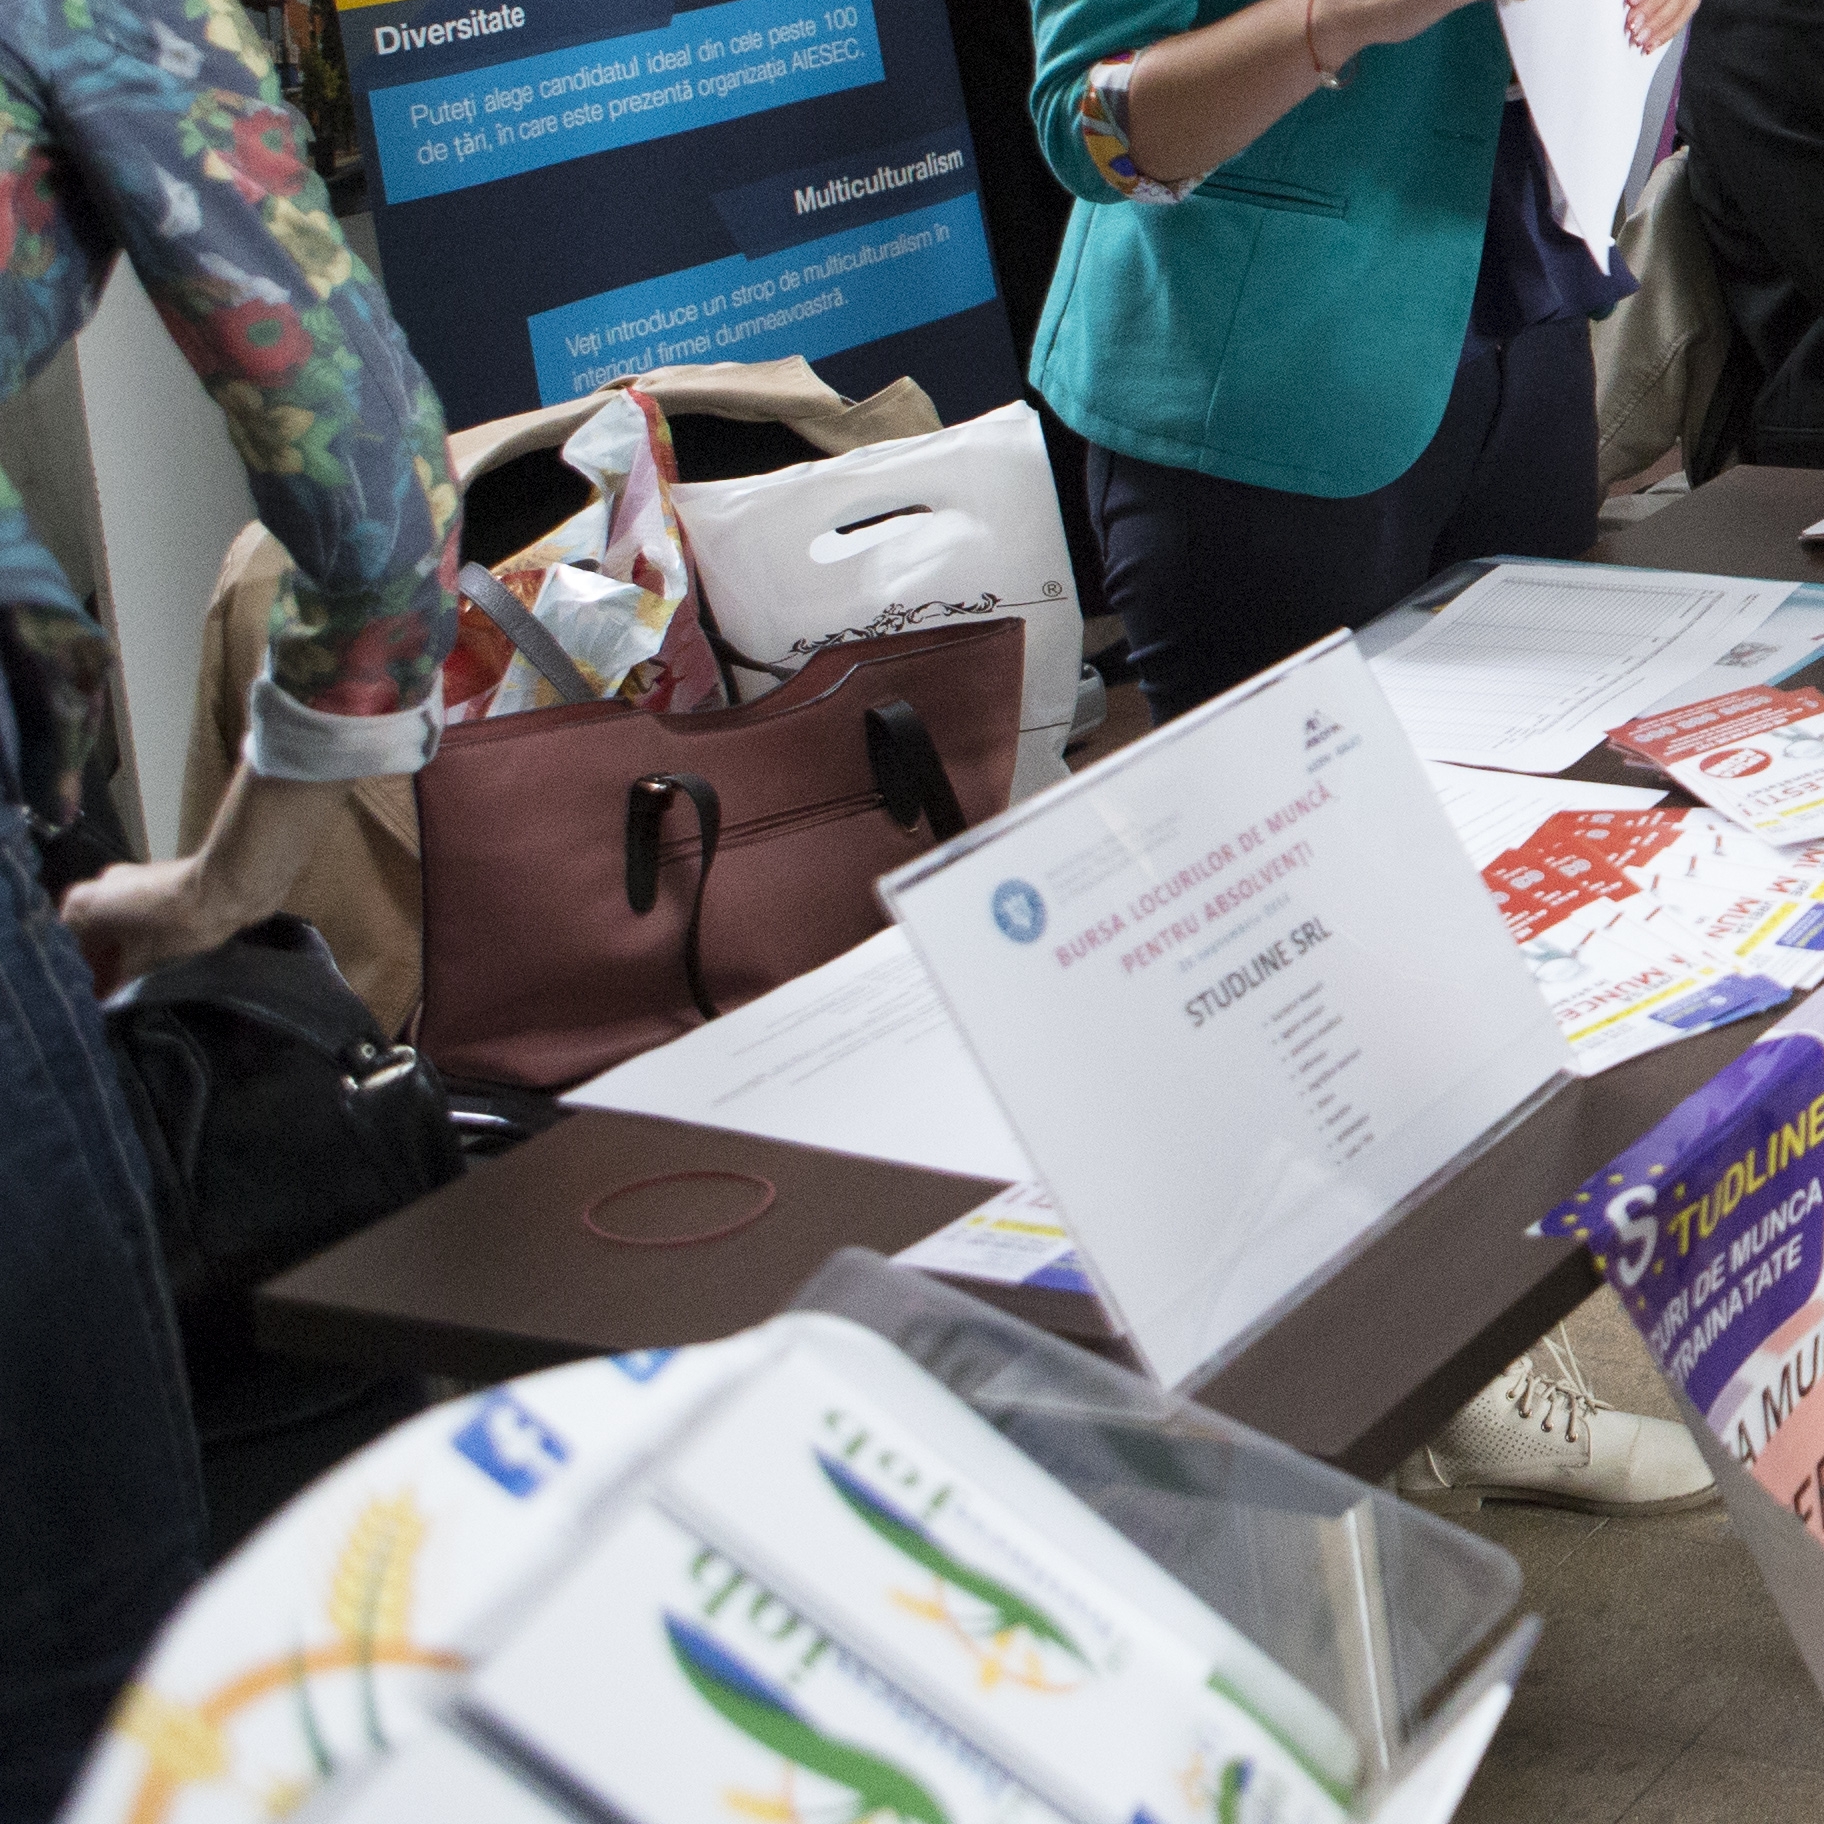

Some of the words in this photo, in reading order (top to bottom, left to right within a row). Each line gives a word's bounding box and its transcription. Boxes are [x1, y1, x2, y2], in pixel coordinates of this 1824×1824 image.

[374, 3, 526, 56] Diversitate
[483, 88, 535, 118] alege
[539, 56, 642, 101] candidatul
[645, 43, 693, 77] ideal
[698, 39, 726, 65] din
[729, 29, 763, 56] cele
[767, 20, 818, 52] peste
[824, 6, 858, 33] 100
[417, 140, 449, 166] de
[497, 123, 517, 148] în
[519, 117, 559, 143] care
[562, 106, 604, 133] este
[607, 82, 694, 126] prezentă
[790, 37, 866, 74] AIESEC.
[793, 148, 965, 217] Multiculturalism
[571, 344, 655, 394] interiorul
[657, 326, 711, 361] firmei
[714, 286, 850, 349] dumneavoastră.
[605, 302, 700, 347] introduce
[701, 295, 728, 317] un
[731, 280, 776, 313] strop
[778, 270, 801, 290] de
[802, 233, 933, 286] multiculturalism
[1055, 913, 1126, 970] BURSA
[1128, 842, 1238, 922] LOCURILOR
[1236, 825, 1264, 855] DE
[1264, 779, 1334, 834] MUNCĂ
[1120, 913, 1200, 974] PENTRU
[1184, 938, 1294, 1029] STUDLINE
[1288, 914, 1334, 957] SRL
[1694, 1260, 1725, 1307] DE
[1729, 1177, 1824, 1272] MUNCA
